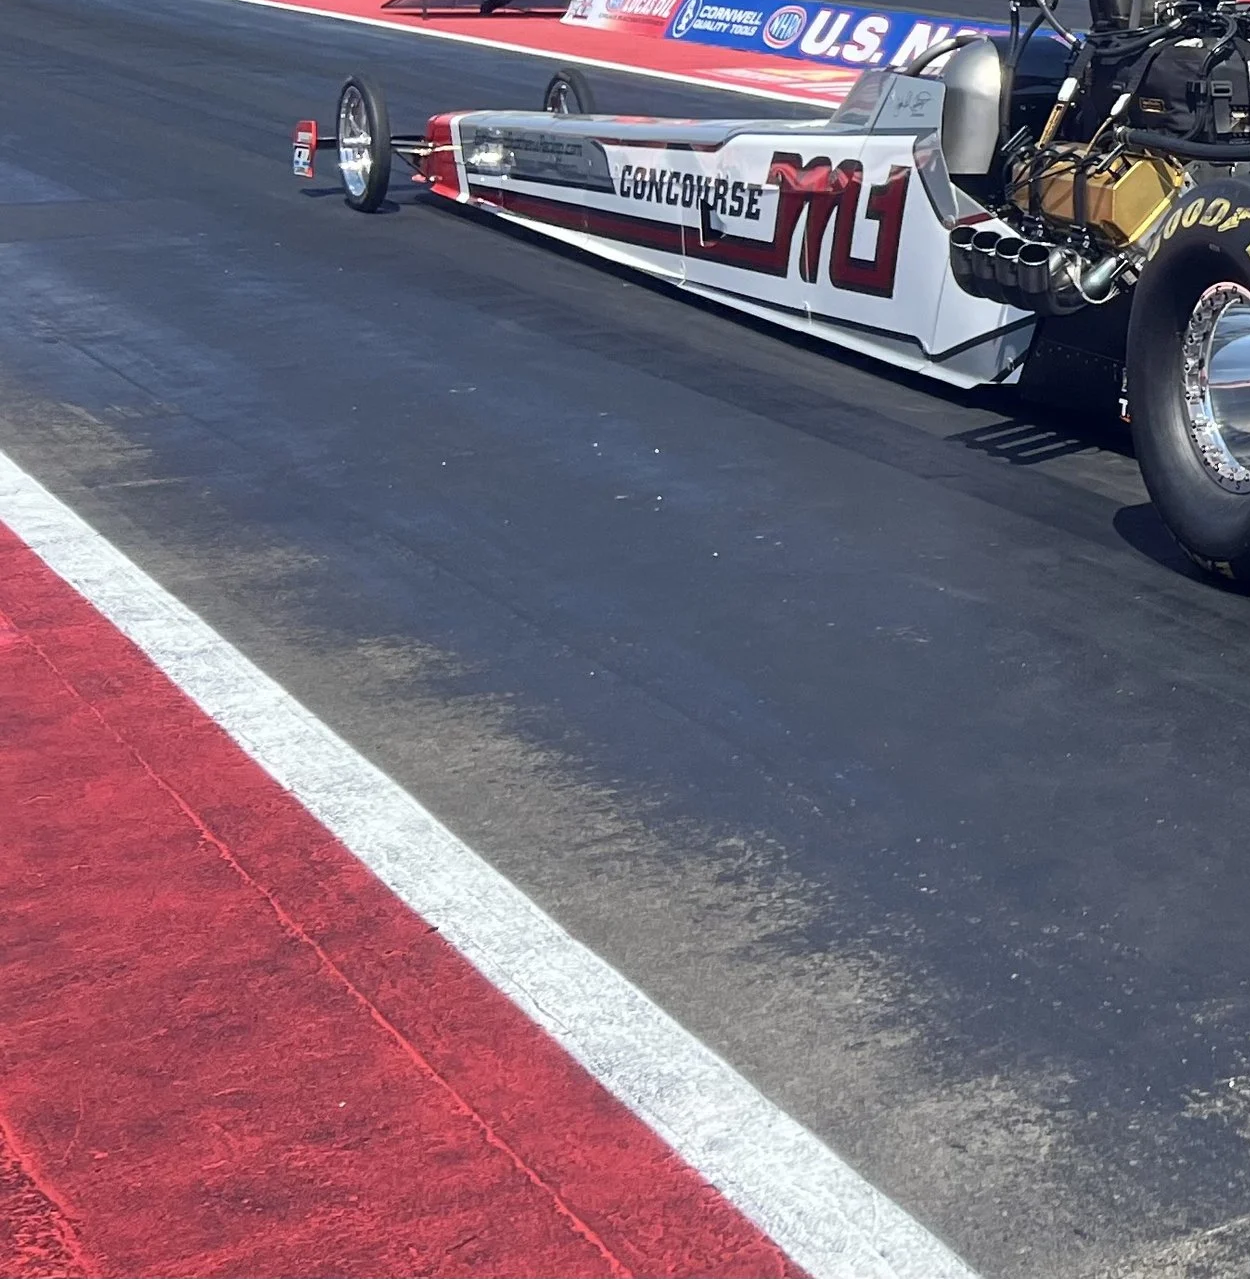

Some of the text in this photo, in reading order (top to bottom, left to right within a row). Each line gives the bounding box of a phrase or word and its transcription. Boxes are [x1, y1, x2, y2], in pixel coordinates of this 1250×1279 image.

[693, 18, 758, 36] QUALITY TOOLS
[700, 5, 763, 25] CORNWELL
[800, 9, 889, 65] U.S.
[620, 164, 763, 220] CONCOURSE
